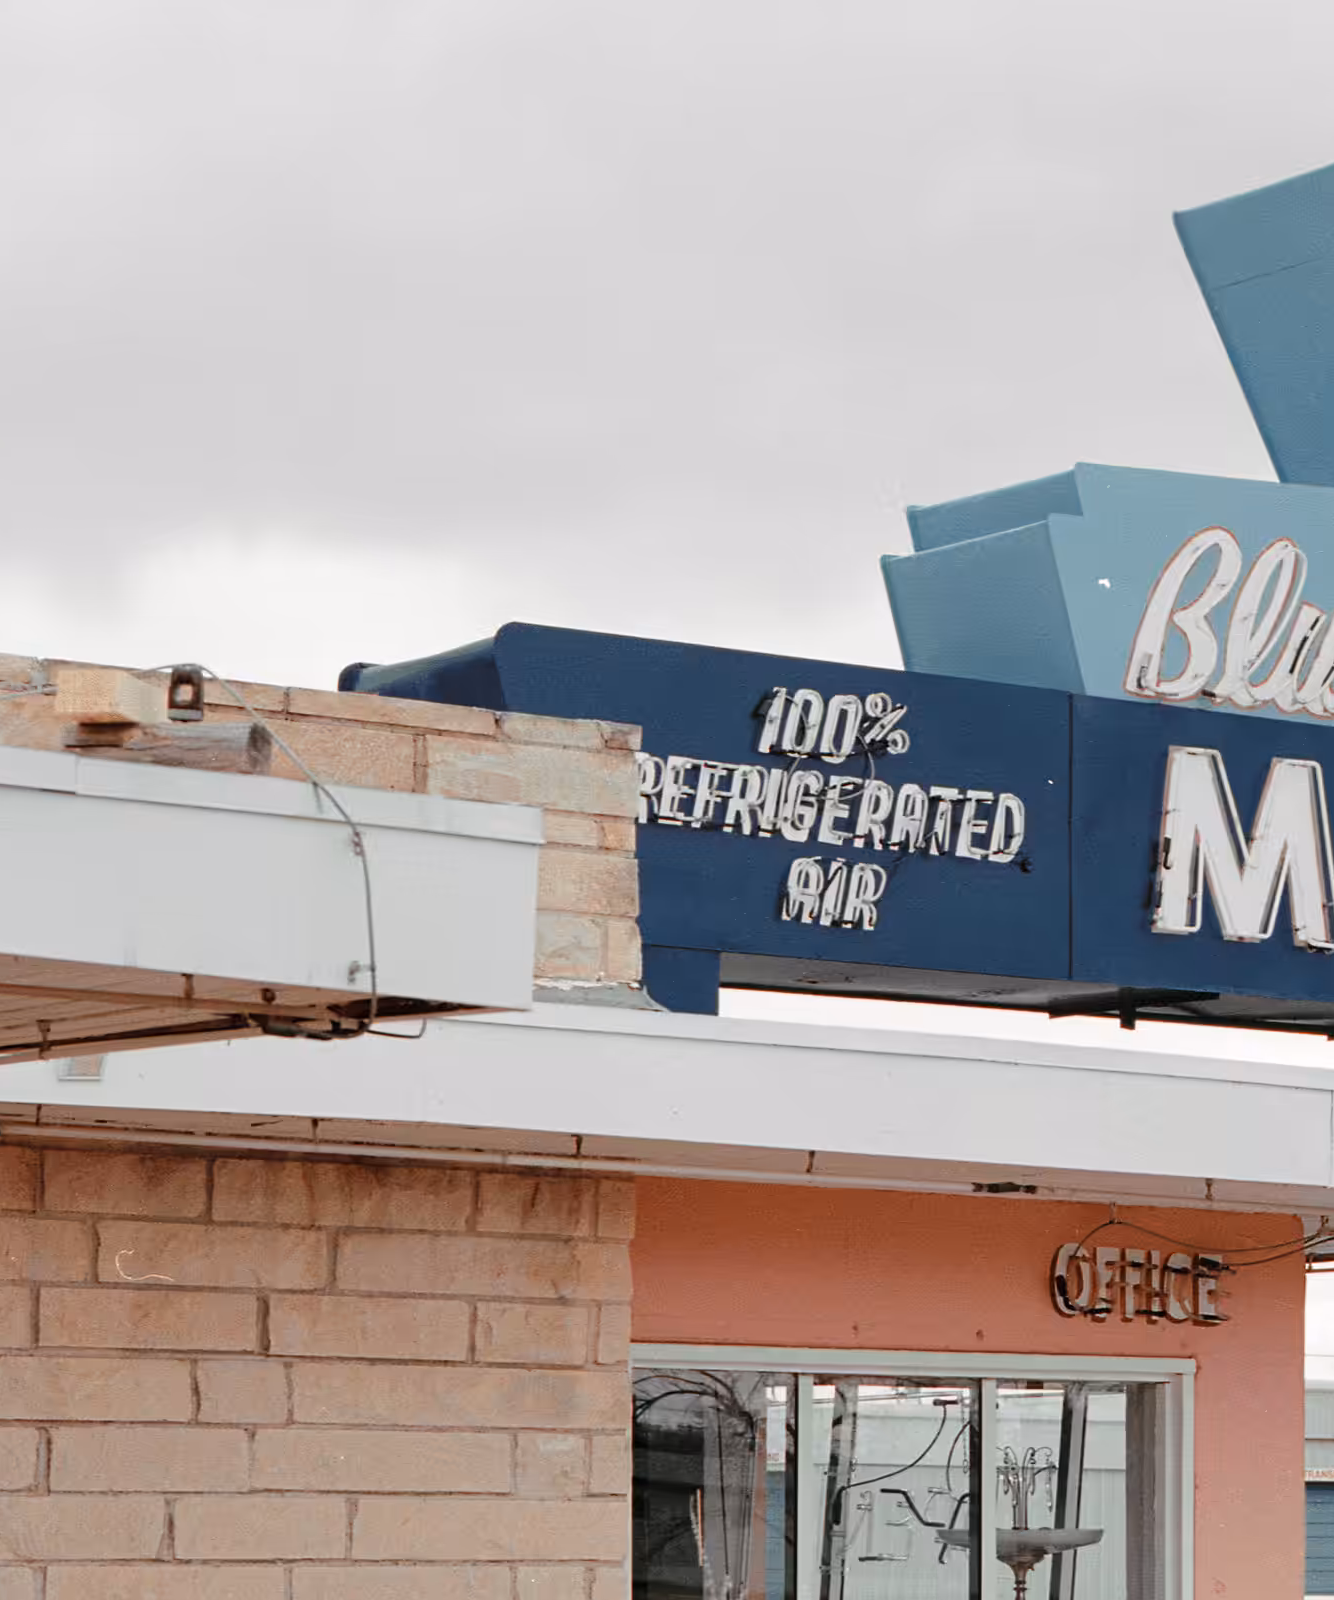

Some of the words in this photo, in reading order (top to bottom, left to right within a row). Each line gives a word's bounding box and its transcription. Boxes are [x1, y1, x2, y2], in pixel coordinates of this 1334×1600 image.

[758, 686, 911, 764] 100%
[637, 751, 1027, 863] REFRIGERATED
[781, 856, 888, 931] AIR
[1052, 1243, 1227, 1324] OFFICE
